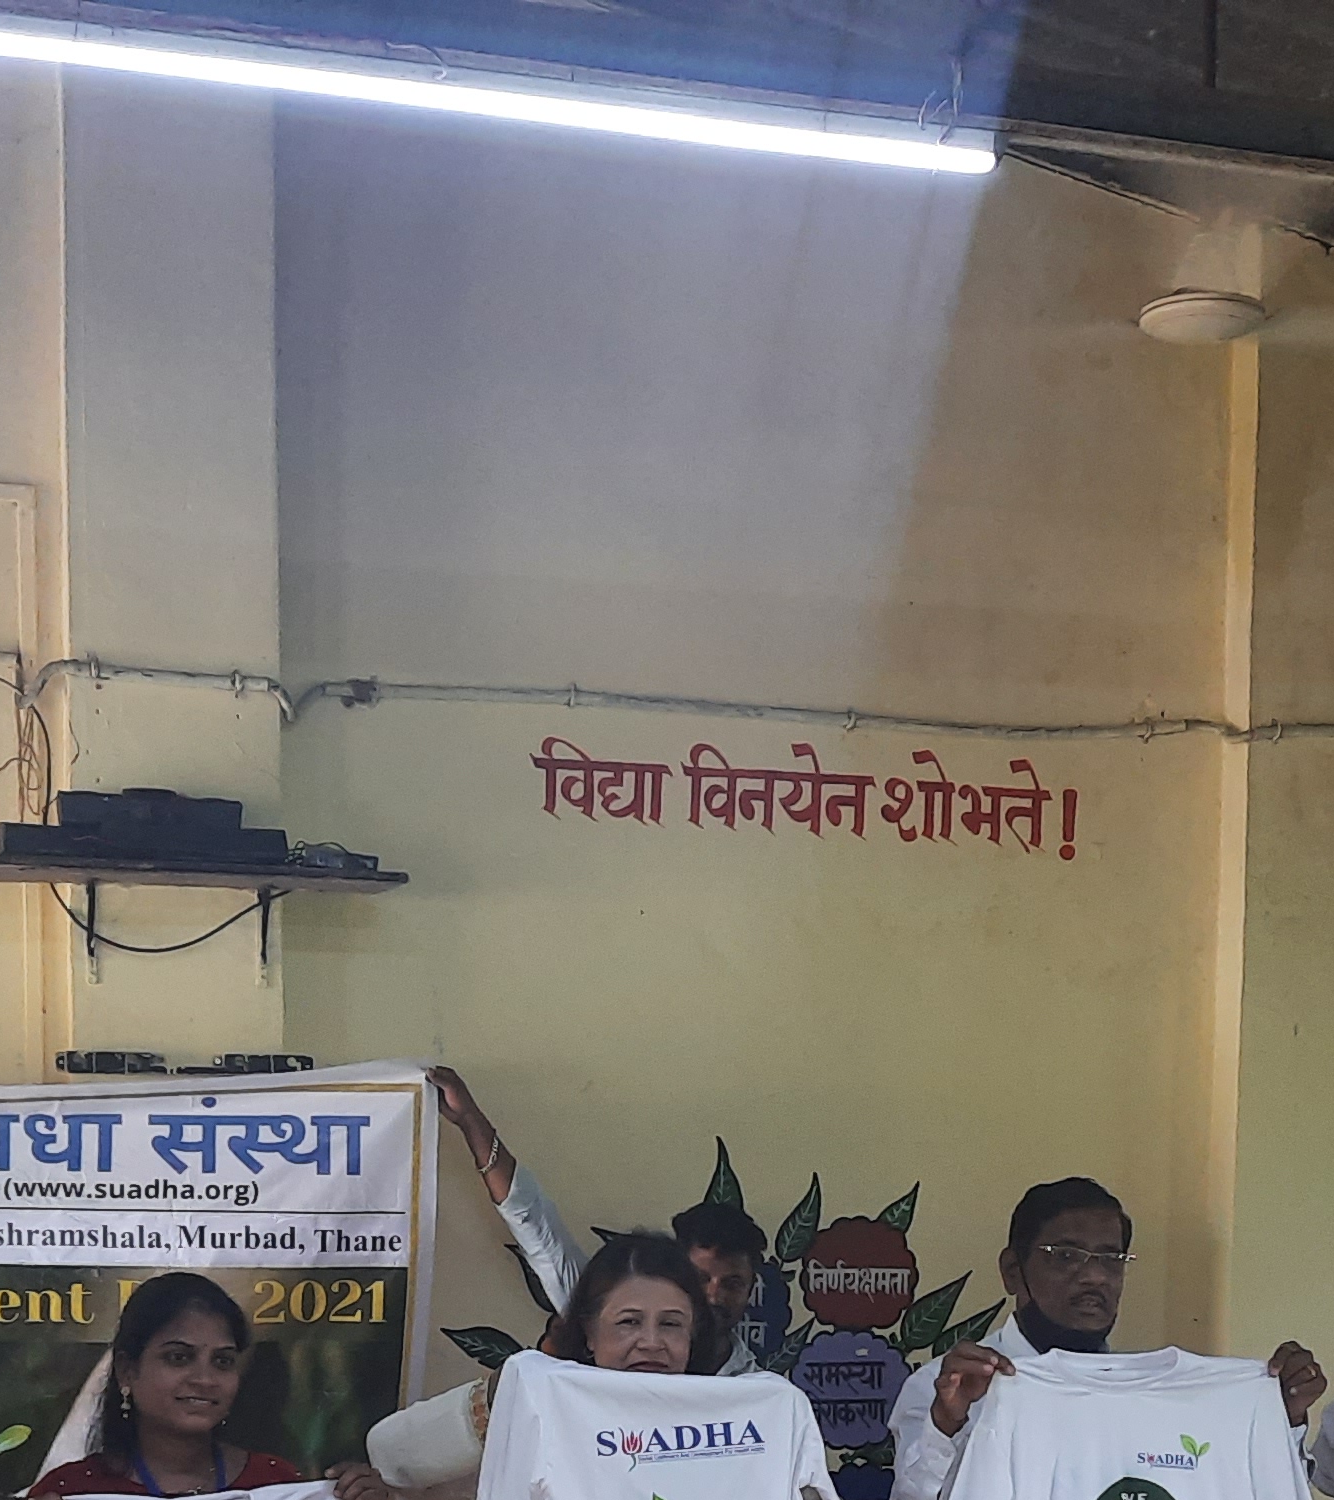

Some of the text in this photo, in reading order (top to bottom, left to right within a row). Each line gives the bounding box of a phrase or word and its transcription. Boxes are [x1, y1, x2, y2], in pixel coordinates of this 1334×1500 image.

[529, 736, 673, 827] विद्या
[681, 743, 877, 839] विनयेन
[148, 1096, 371, 1176] संस्था
[3, 1178, 259, 1206] (www.suadha.org)
[177, 1225, 305, 1254] Murbad,
[313, 1228, 402, 1253] Thane
[252, 1280, 388, 1325] 2021
